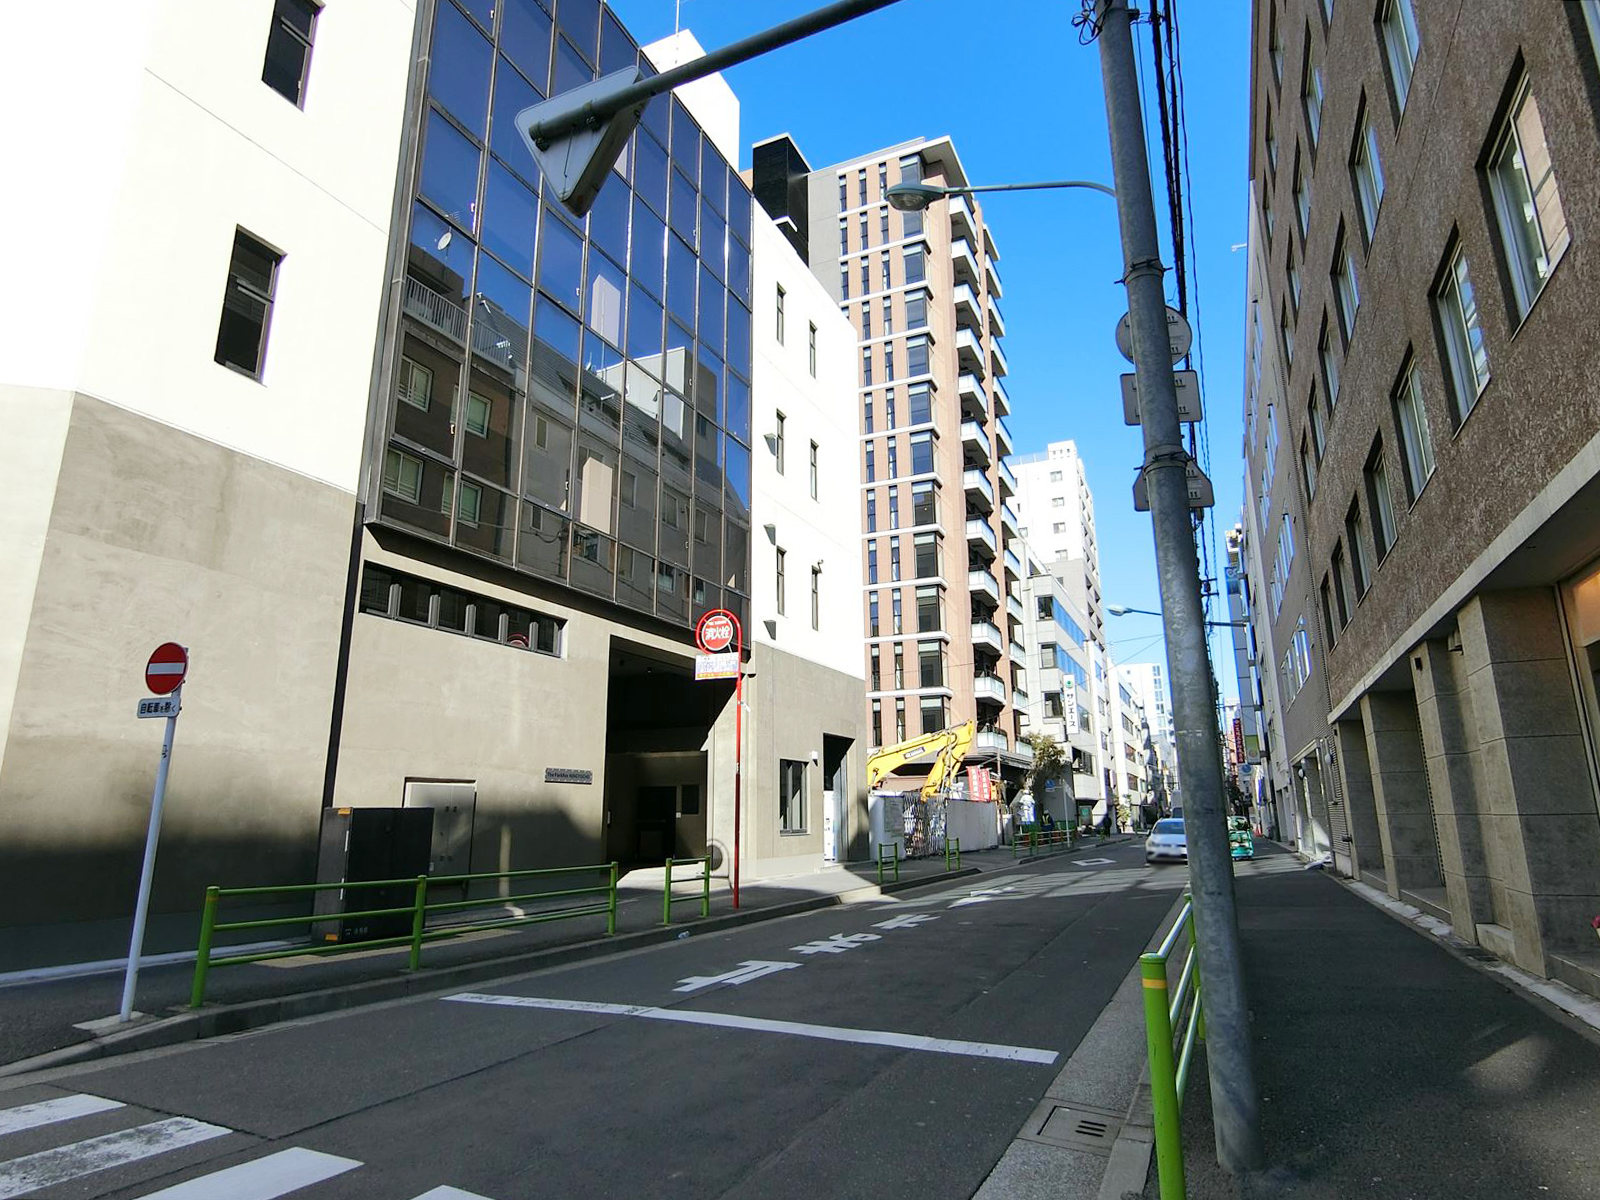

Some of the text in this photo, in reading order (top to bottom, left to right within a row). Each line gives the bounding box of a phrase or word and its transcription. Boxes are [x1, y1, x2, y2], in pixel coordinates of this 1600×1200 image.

[705, 626, 730, 640] 消火栓
[1066, 694, 1076, 727] サンエース
